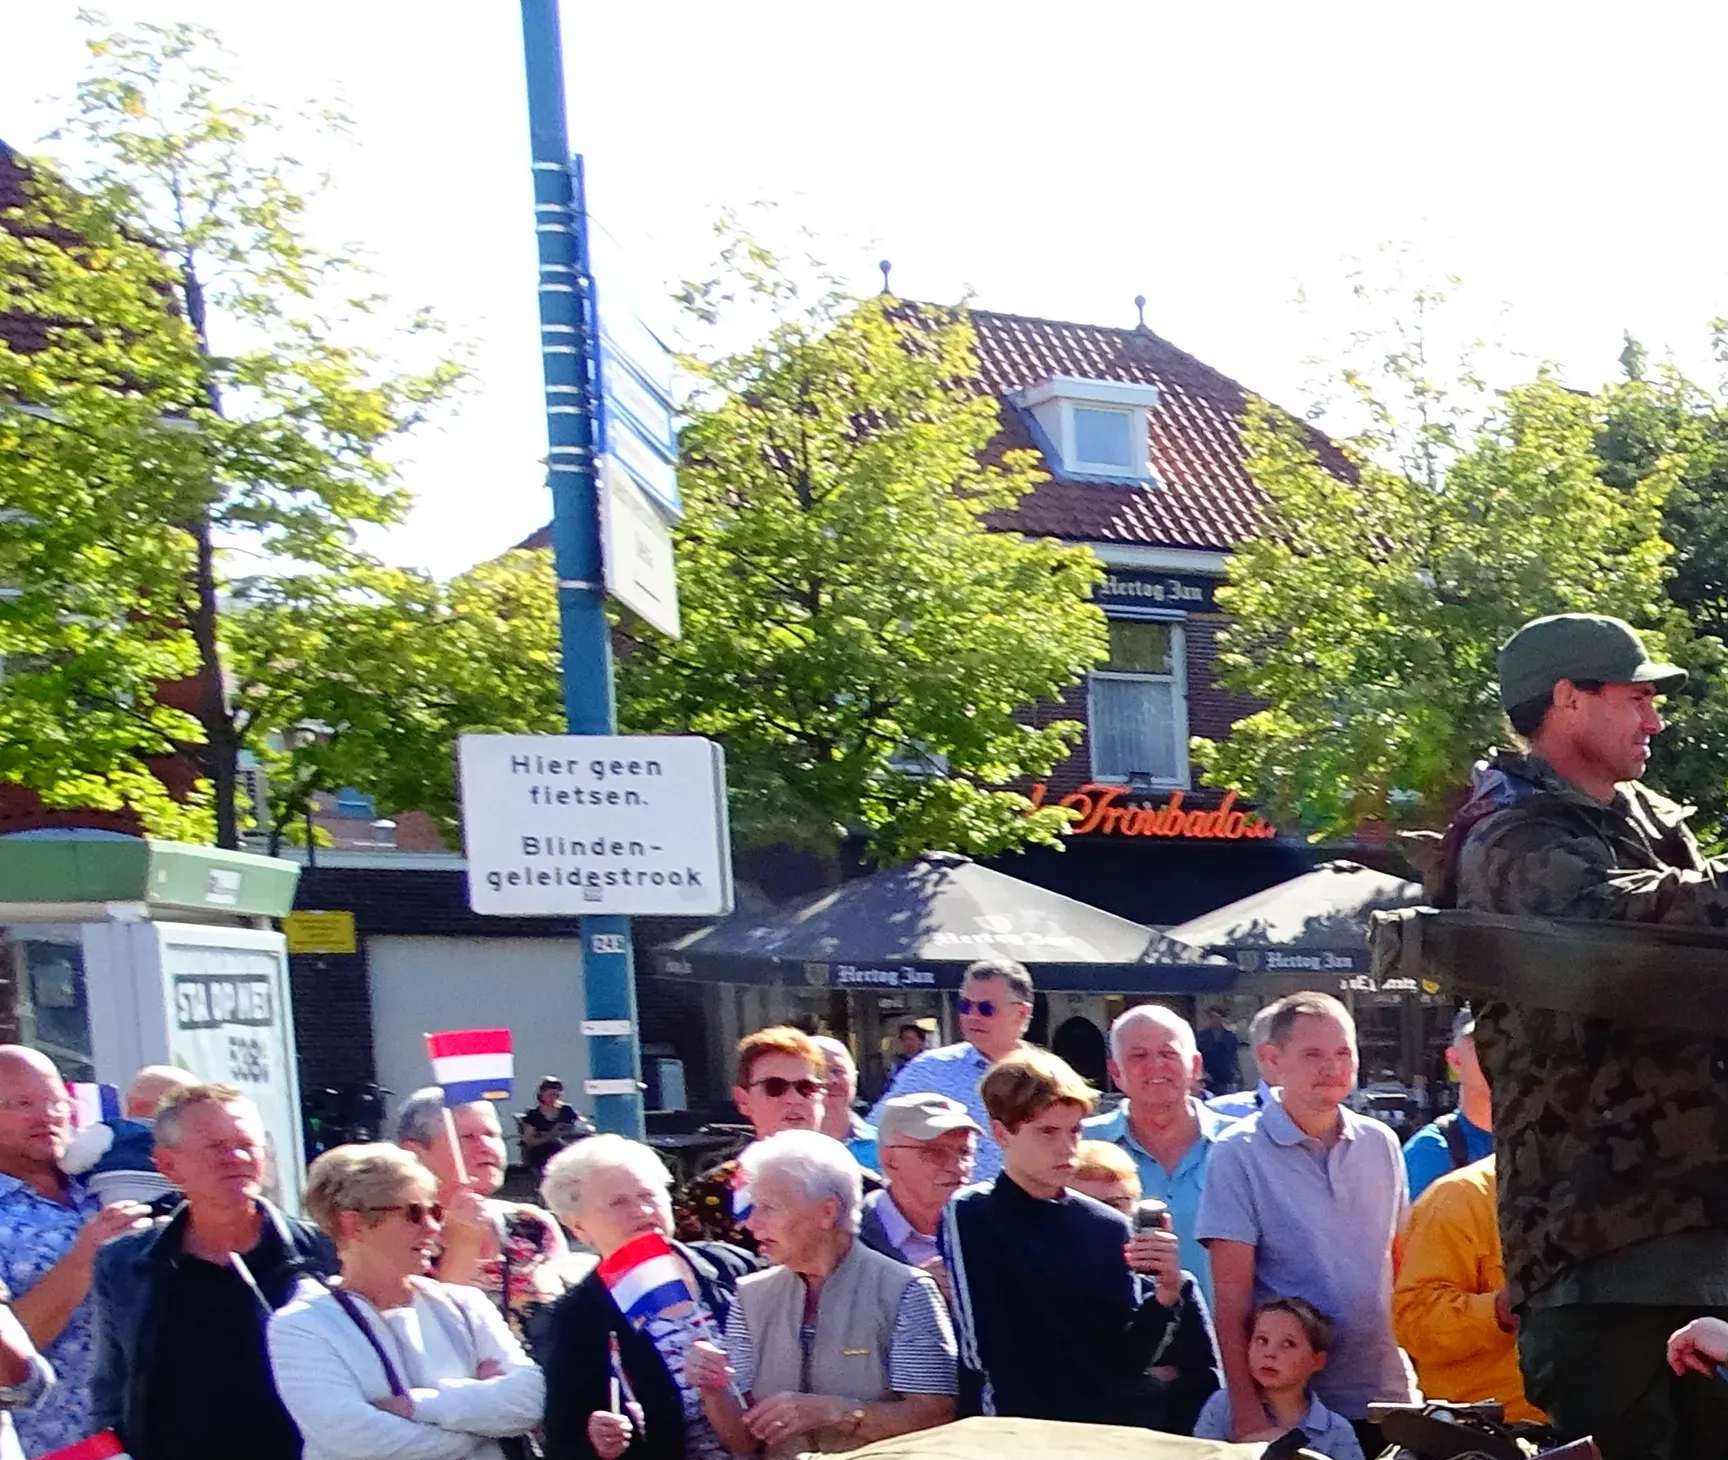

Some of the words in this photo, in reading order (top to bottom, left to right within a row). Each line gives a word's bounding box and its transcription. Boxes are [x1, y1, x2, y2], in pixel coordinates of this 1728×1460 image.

[1098, 574, 1166, 602] Hertog
[1167, 578, 1204, 604] Jan
[510, 754, 579, 777] Hier
[588, 758, 663, 780] geen
[529, 785, 650, 806] fietsen.
[521, 836, 665, 857] Blinden-
[486, 867, 703, 891] geleidestrook
[1265, 950, 1321, 971] Hertog
[1321, 950, 1354, 970] Jan
[836, 964, 900, 987] Hertog
[901, 966, 937, 986] Jan
